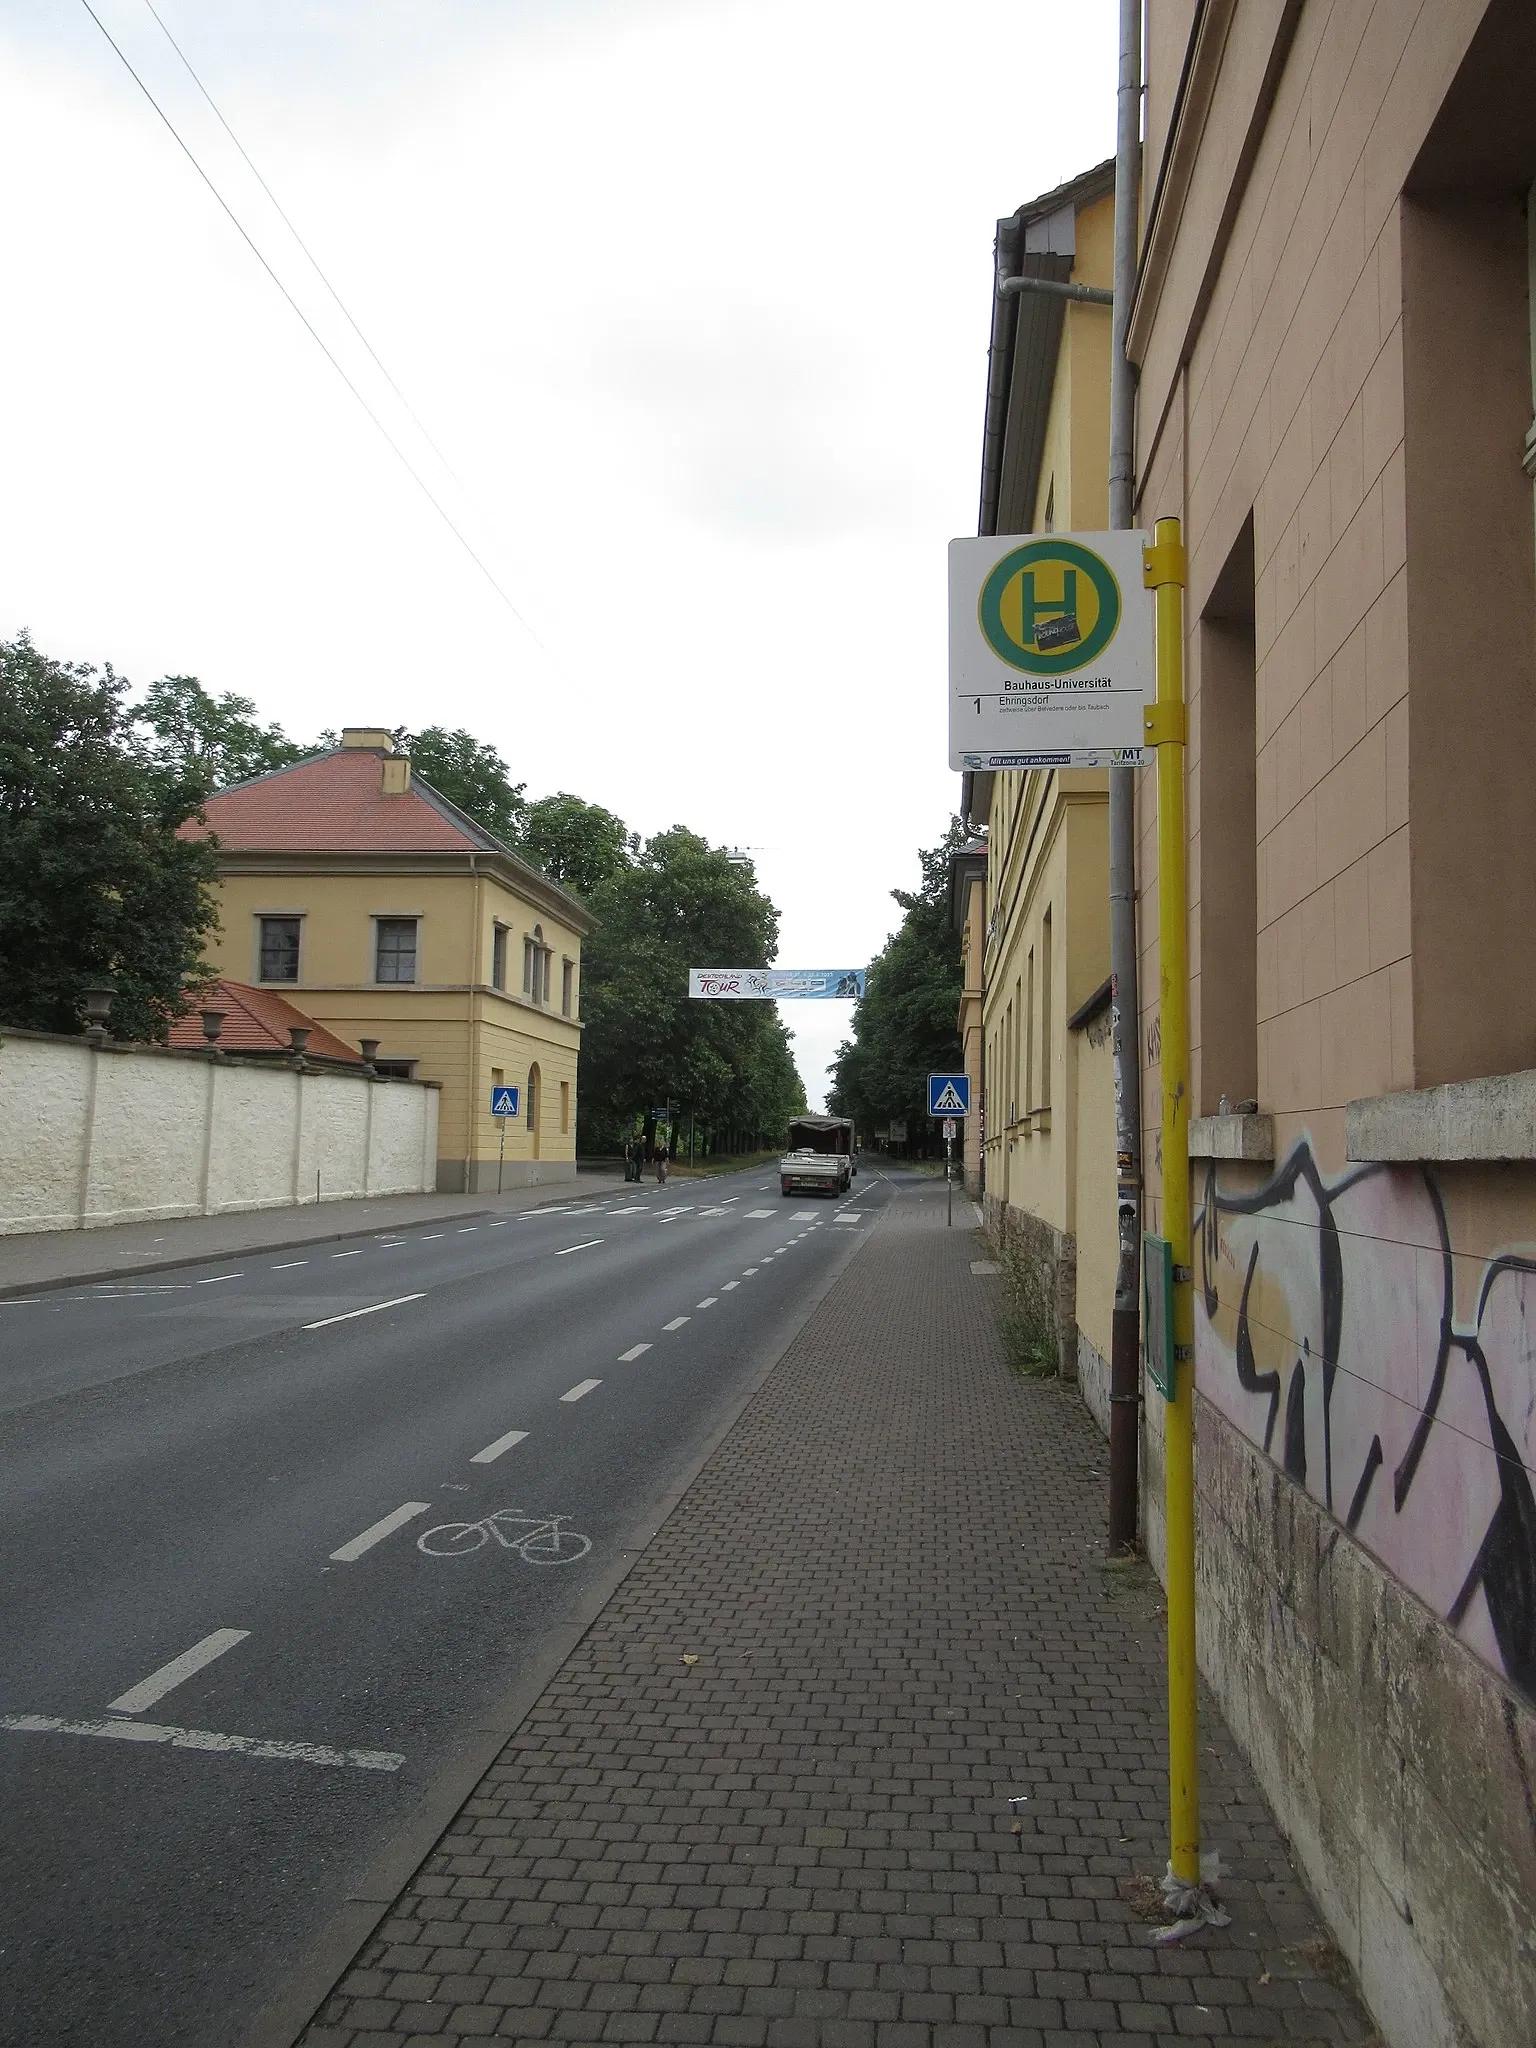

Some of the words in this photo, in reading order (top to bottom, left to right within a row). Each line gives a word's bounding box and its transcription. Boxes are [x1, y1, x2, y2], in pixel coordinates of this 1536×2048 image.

[1022, 569, 1076, 645] H
[1004, 677, 1112, 691] Bauhaus-Universität
[973, 697, 982, 714] 1
[999, 694, 1050, 707] Ehringsdorf
[1037, 704, 1064, 712] Belvedere
[1065, 703, 1078, 711] oder
[1087, 703, 1110, 711] Taubach
[1112, 749, 1142, 760] VMT
[1003, 757, 1015, 765] uns
[1016, 757, 1029, 766] gut
[1029, 756, 1070, 764] ankommen!
